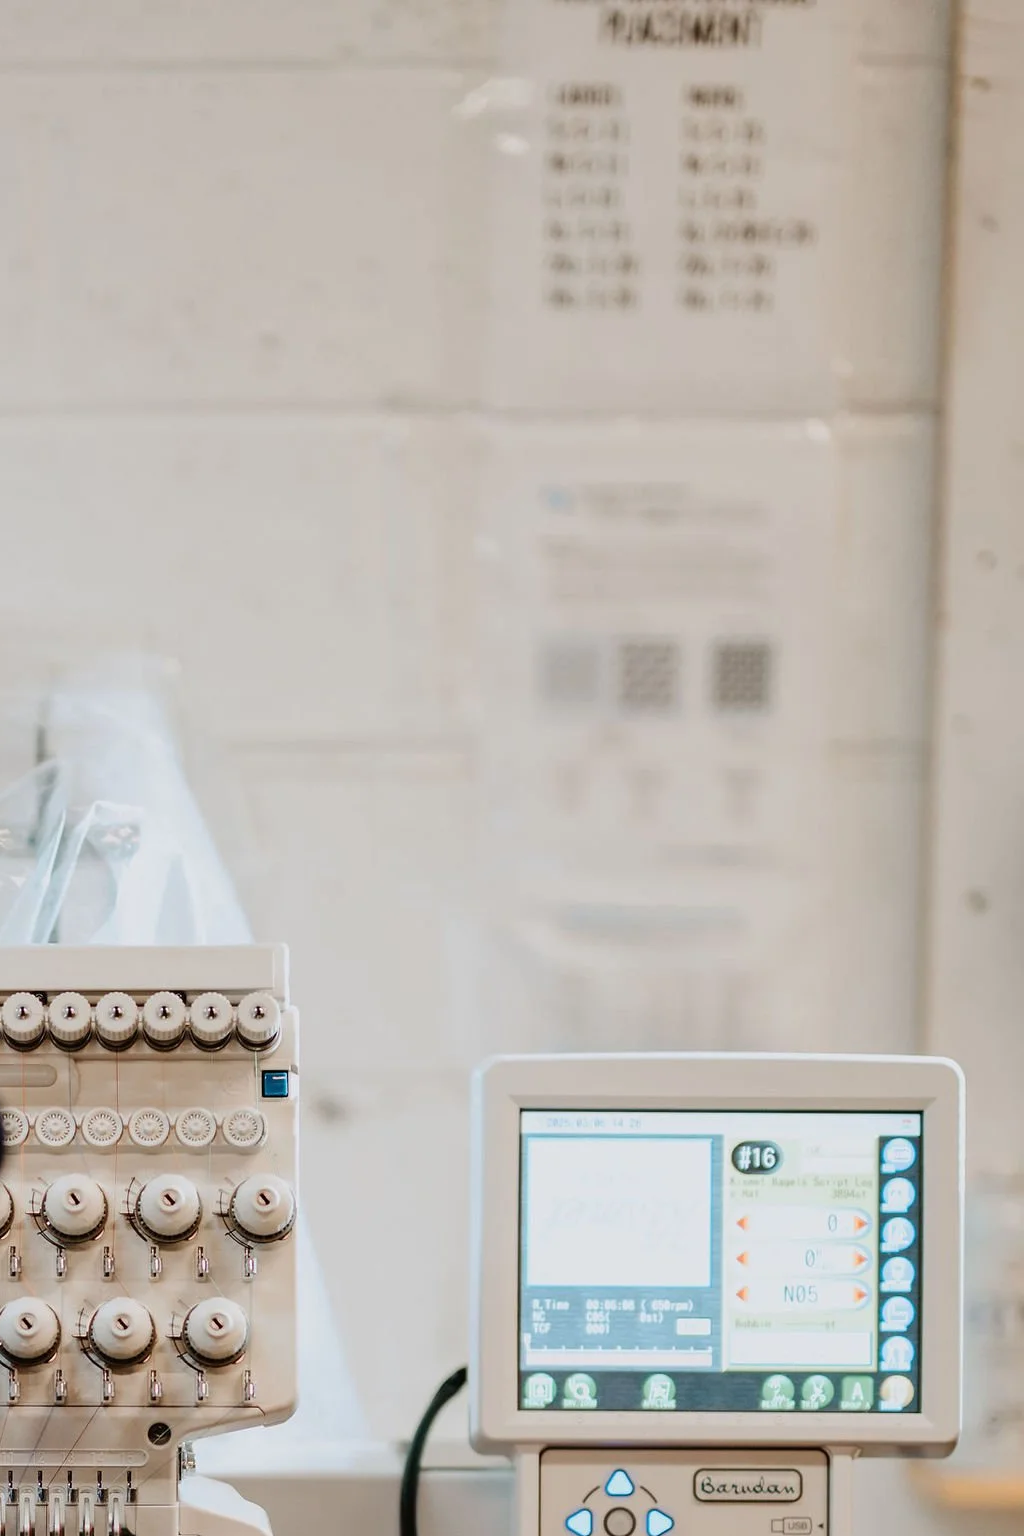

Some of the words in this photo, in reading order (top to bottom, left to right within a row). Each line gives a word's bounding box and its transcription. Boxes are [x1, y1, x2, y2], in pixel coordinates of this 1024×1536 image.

[739, 1146, 775, 1170] #16
[701, 1476, 795, 1494] Barudan
[788, 1522, 807, 1531] USB
